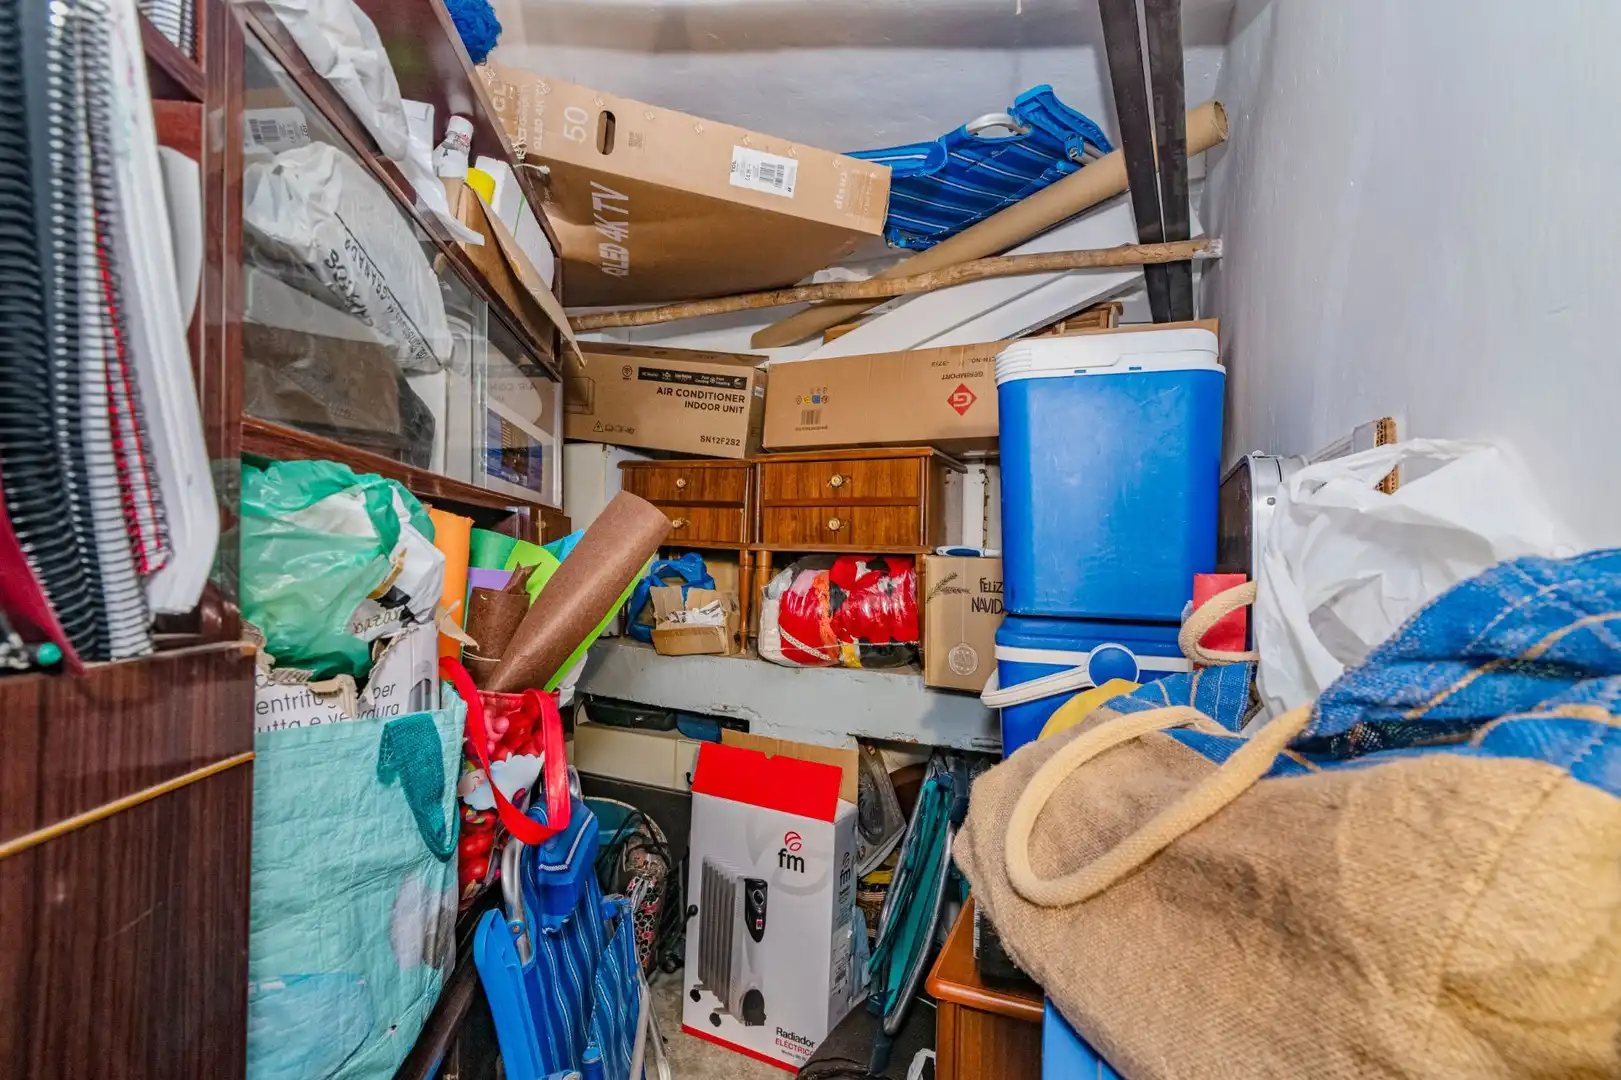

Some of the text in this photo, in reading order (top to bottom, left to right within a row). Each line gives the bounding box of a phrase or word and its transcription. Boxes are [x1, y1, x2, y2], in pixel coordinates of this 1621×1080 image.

[533, 118, 543, 150] QLED
[563, 105, 589, 145] 50
[590, 180, 630, 278] QLED 4K TV
[942, 371, 983, 380] GERIMPORT
[656, 386, 745, 403] AIR CONDITIONER
[684, 400, 745, 414] INDOOR UNIT
[700, 435, 741, 446] SN12F2S2
[971, 596, 1003, 615] NAVID
[352, 607, 402, 634] bazar
[372, 682, 397, 702] per
[778, 848, 804, 874] fm
[839, 868, 851, 887] fm
[775, 1038, 816, 1057] ELÉCTRICO
[776, 1027, 816, 1049] Radiador
